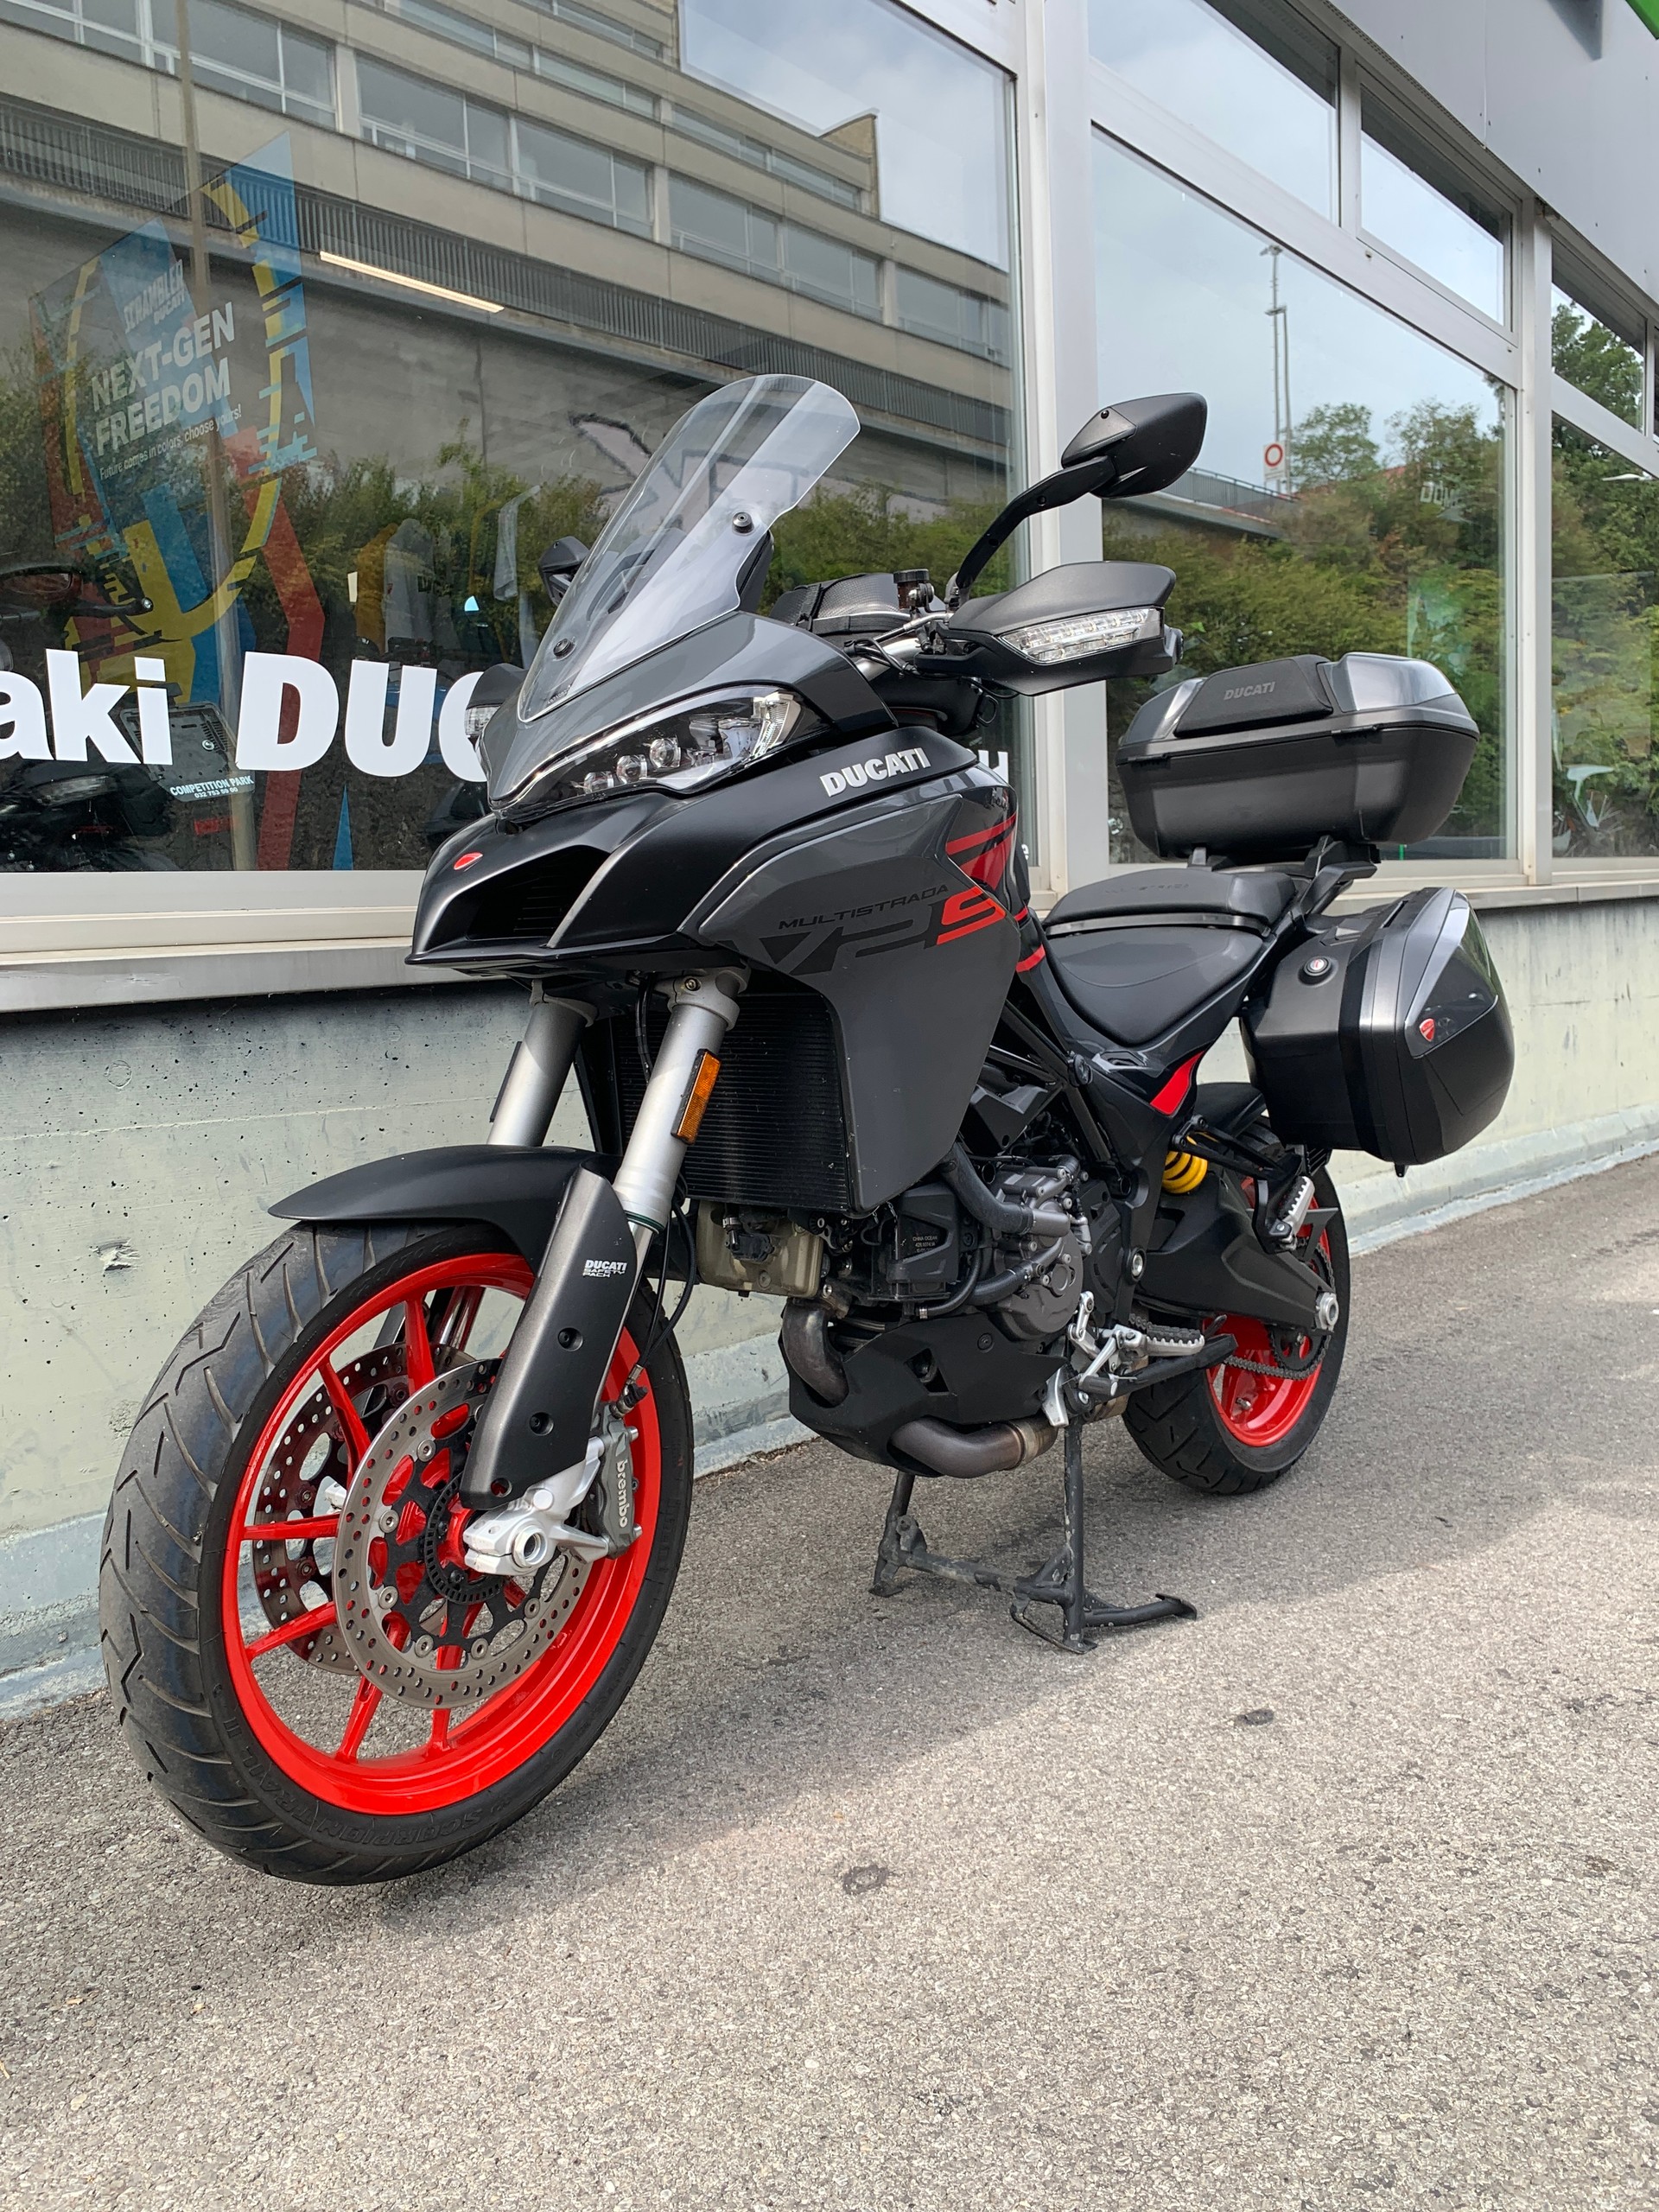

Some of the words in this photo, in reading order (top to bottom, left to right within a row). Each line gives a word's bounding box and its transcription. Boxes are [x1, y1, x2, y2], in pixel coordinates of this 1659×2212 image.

[91, 302, 235, 412] NEXT-GEN
[95, 357, 231, 456] FREEDOM
[99, 460, 124, 480] Future
[124, 450, 148, 469] comes
[149, 446, 157, 458] in
[184, 418, 214, 442] choose
[215, 404, 242, 432] yours!
[0, 648, 173, 766] aki
[1224, 681, 1276, 701] DUCATI
[170, 779, 231, 796] COMPETITION
[229, 775, 255, 787] PARK
[820, 747, 931, 798] DUCATI
[779, 884, 949, 930] MULTISTRADA
[584, 1259, 628, 1271] DUCATI
[616, 1459, 630, 1528] brembo
[242, 1746, 317, 1826] TRAIL
[316, 1809, 482, 1847] SCORPION
